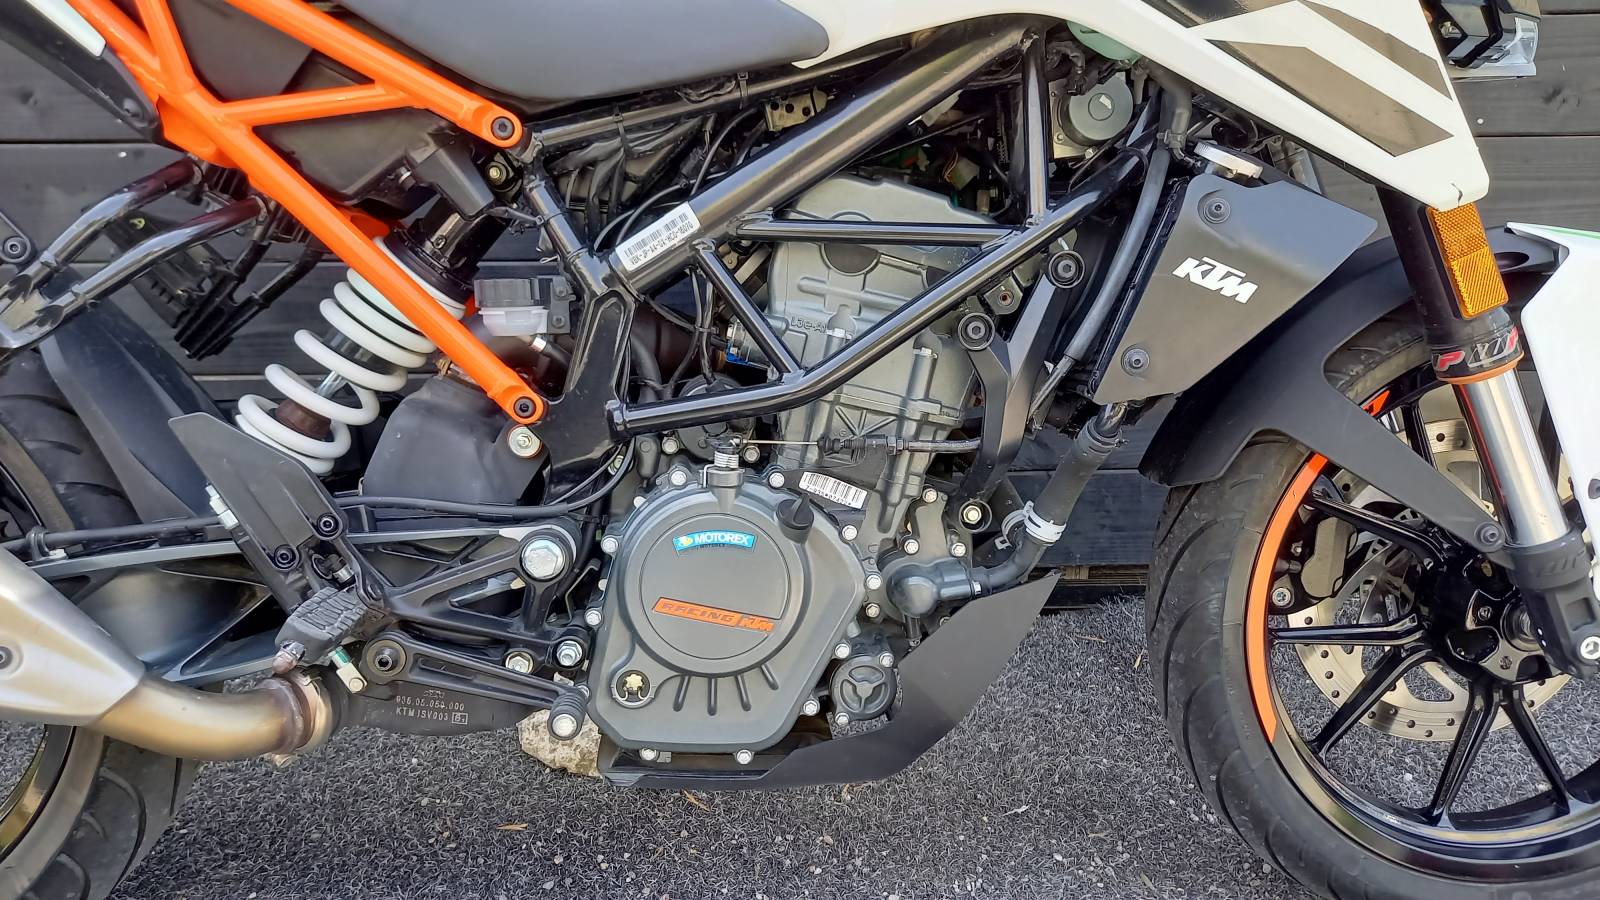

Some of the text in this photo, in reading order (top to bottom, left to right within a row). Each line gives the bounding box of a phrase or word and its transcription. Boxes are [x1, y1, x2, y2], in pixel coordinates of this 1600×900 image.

[1172, 256, 1258, 304] KTM
[694, 532, 749, 546] MOTOREX
[660, 602, 775, 632] RACING KTM
